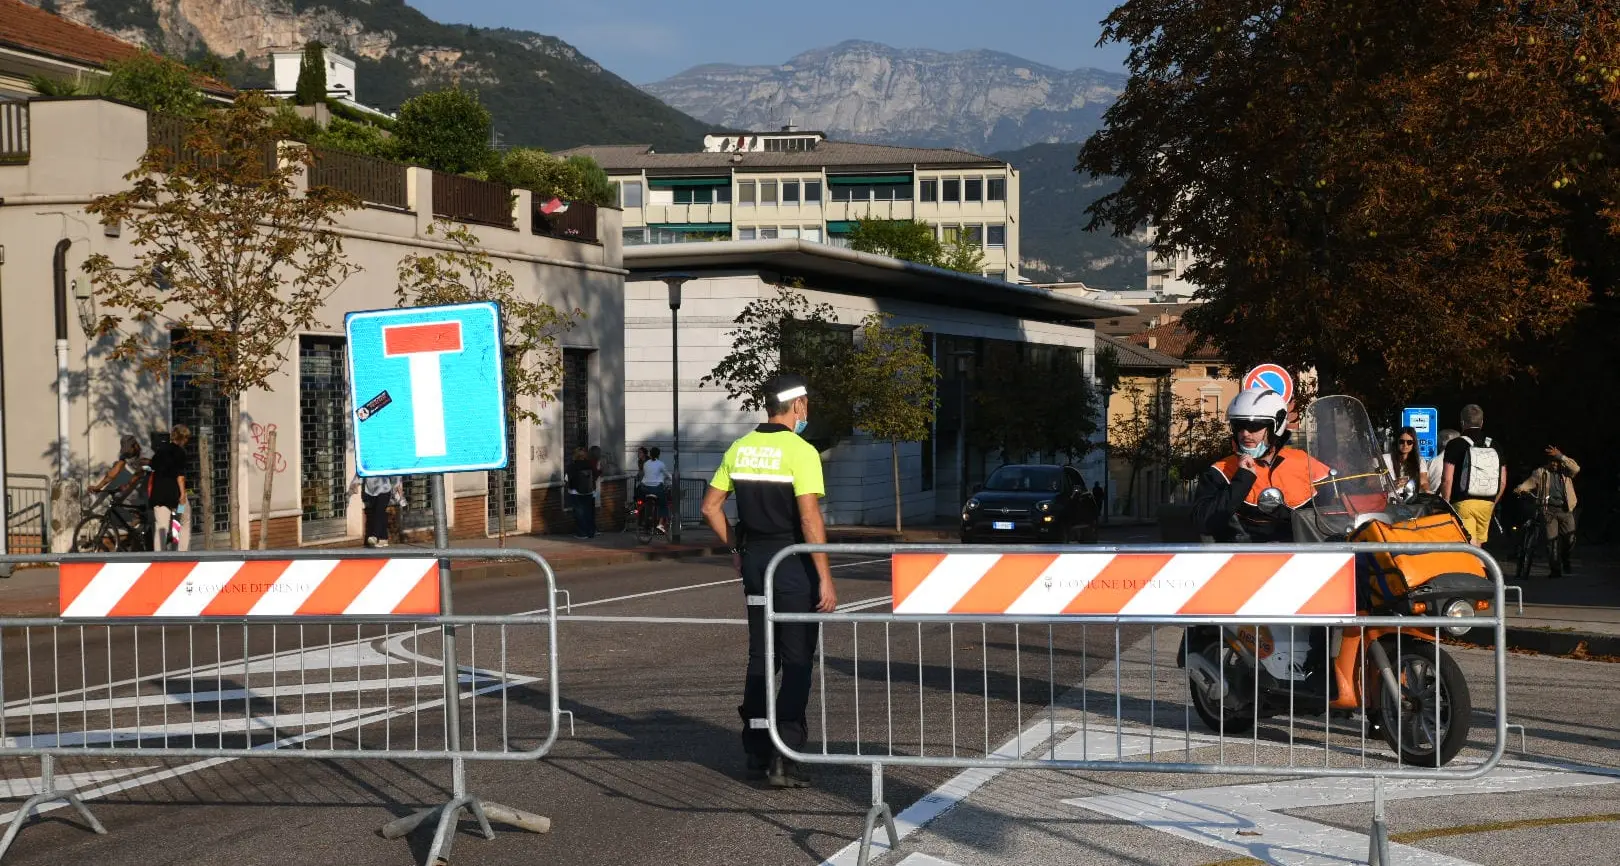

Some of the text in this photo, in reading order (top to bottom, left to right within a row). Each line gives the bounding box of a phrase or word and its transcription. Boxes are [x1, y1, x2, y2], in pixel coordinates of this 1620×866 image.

[736, 446, 782, 459] POLIZIA
[735, 456, 781, 470] LOCALE
[198, 583, 247, 594] COMUNE
[250, 583, 262, 593] DI
[1058, 578, 1120, 590] COMUNE
[1123, 579, 1137, 590] DI
